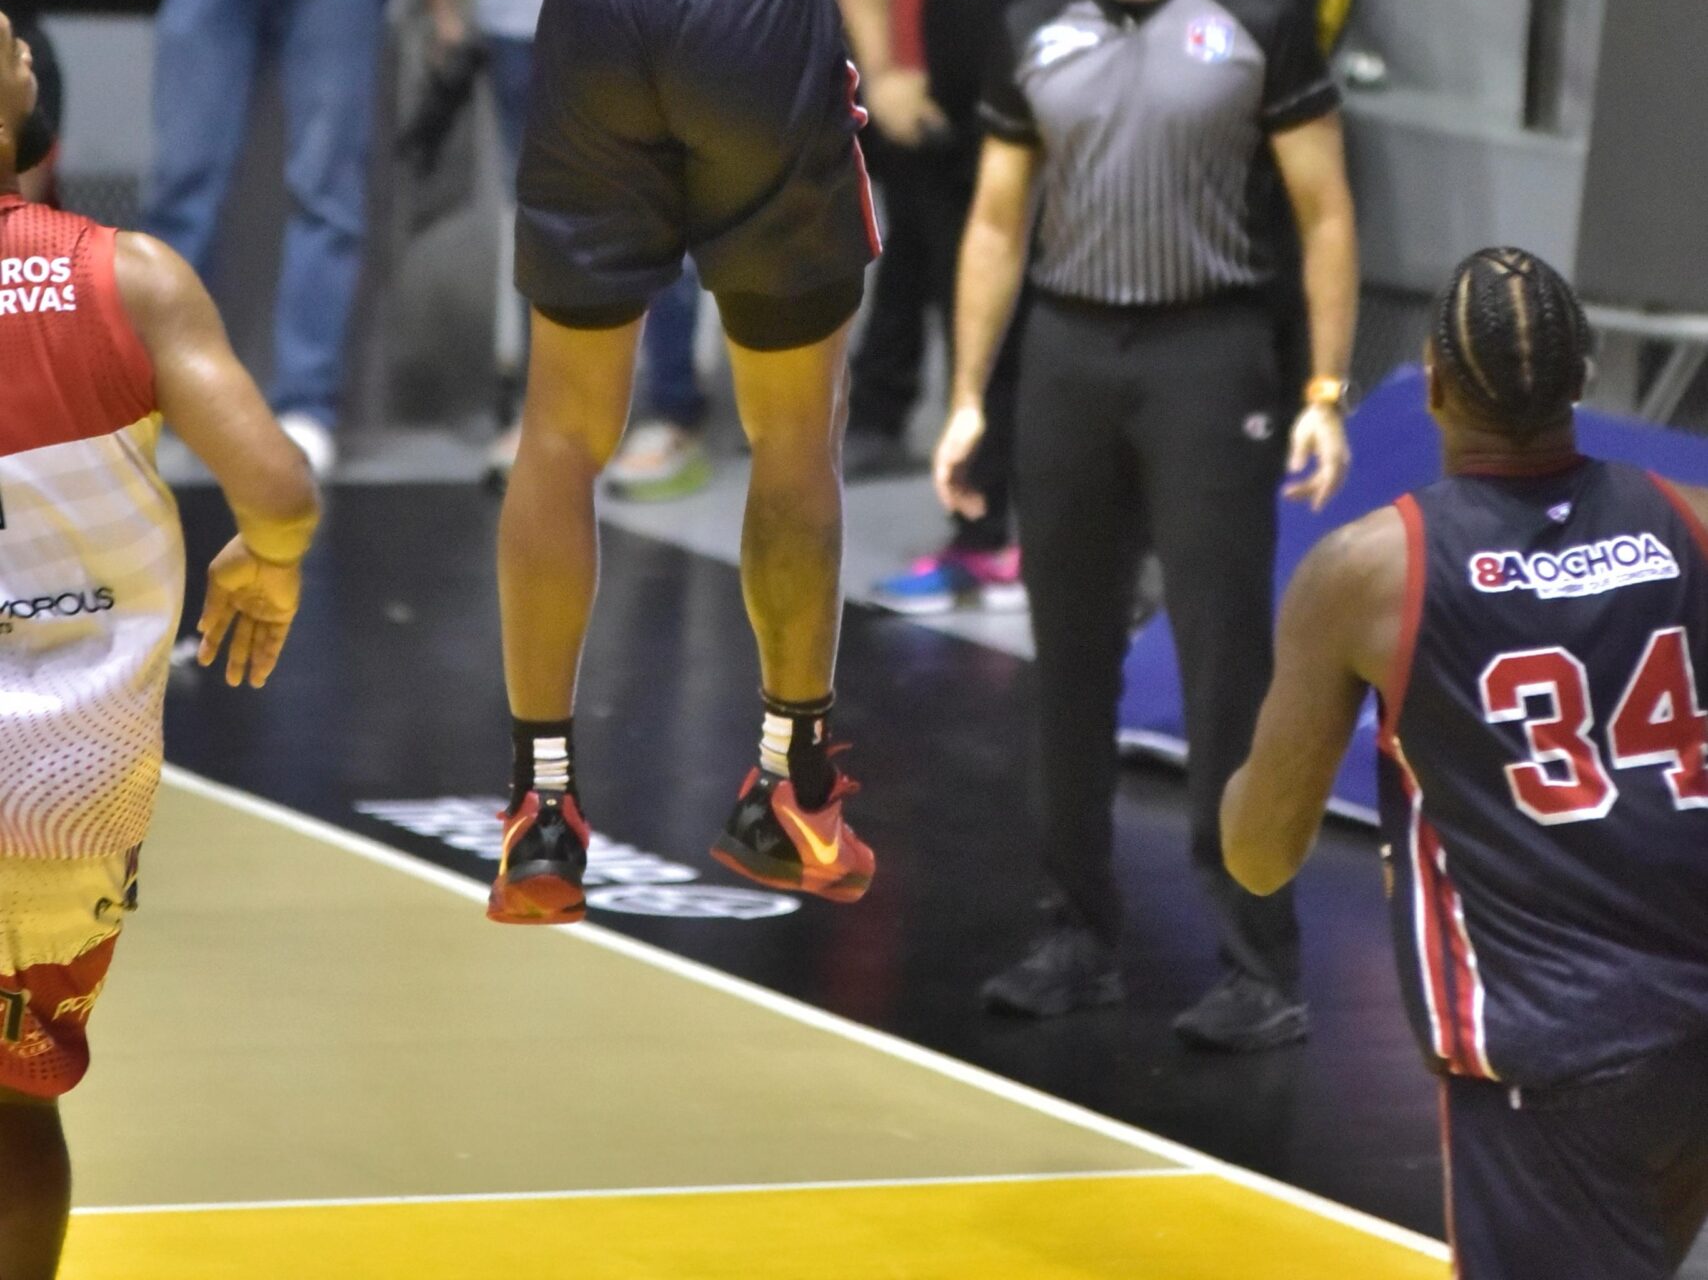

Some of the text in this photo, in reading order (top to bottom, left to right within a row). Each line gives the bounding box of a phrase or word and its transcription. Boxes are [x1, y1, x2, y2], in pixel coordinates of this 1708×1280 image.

[1, 256, 72, 285] ROS
[0, 285, 77, 316] RVAS
[1475, 556, 1530, 587] 8A
[1533, 537, 1668, 581] OCHOA
[1479, 626, 1708, 826] 34
